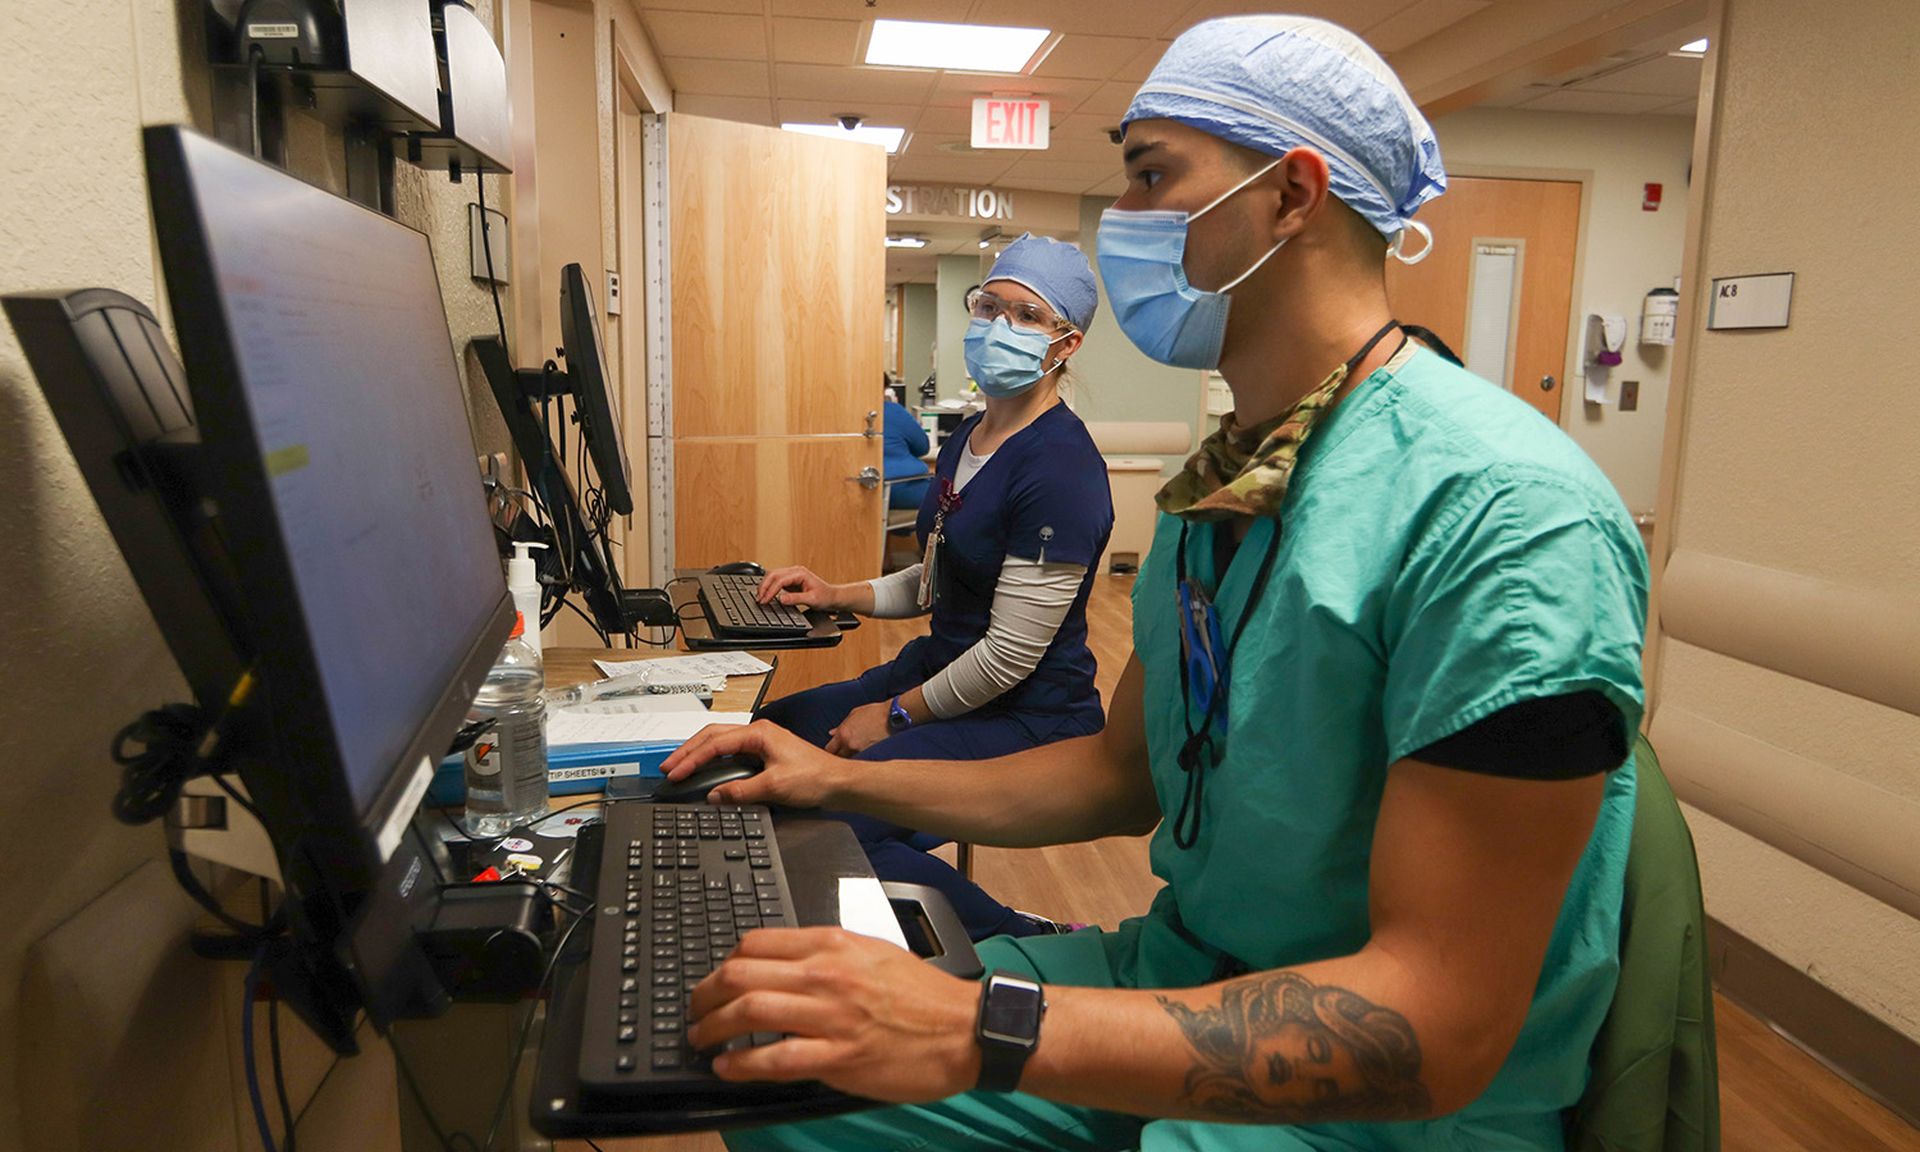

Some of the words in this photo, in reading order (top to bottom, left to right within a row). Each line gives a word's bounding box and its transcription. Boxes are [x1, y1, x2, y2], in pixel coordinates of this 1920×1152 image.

[986, 101, 1040, 145] EXIT
[885, 185, 1013, 219] STRATION
[549, 771, 563, 780] TIP
